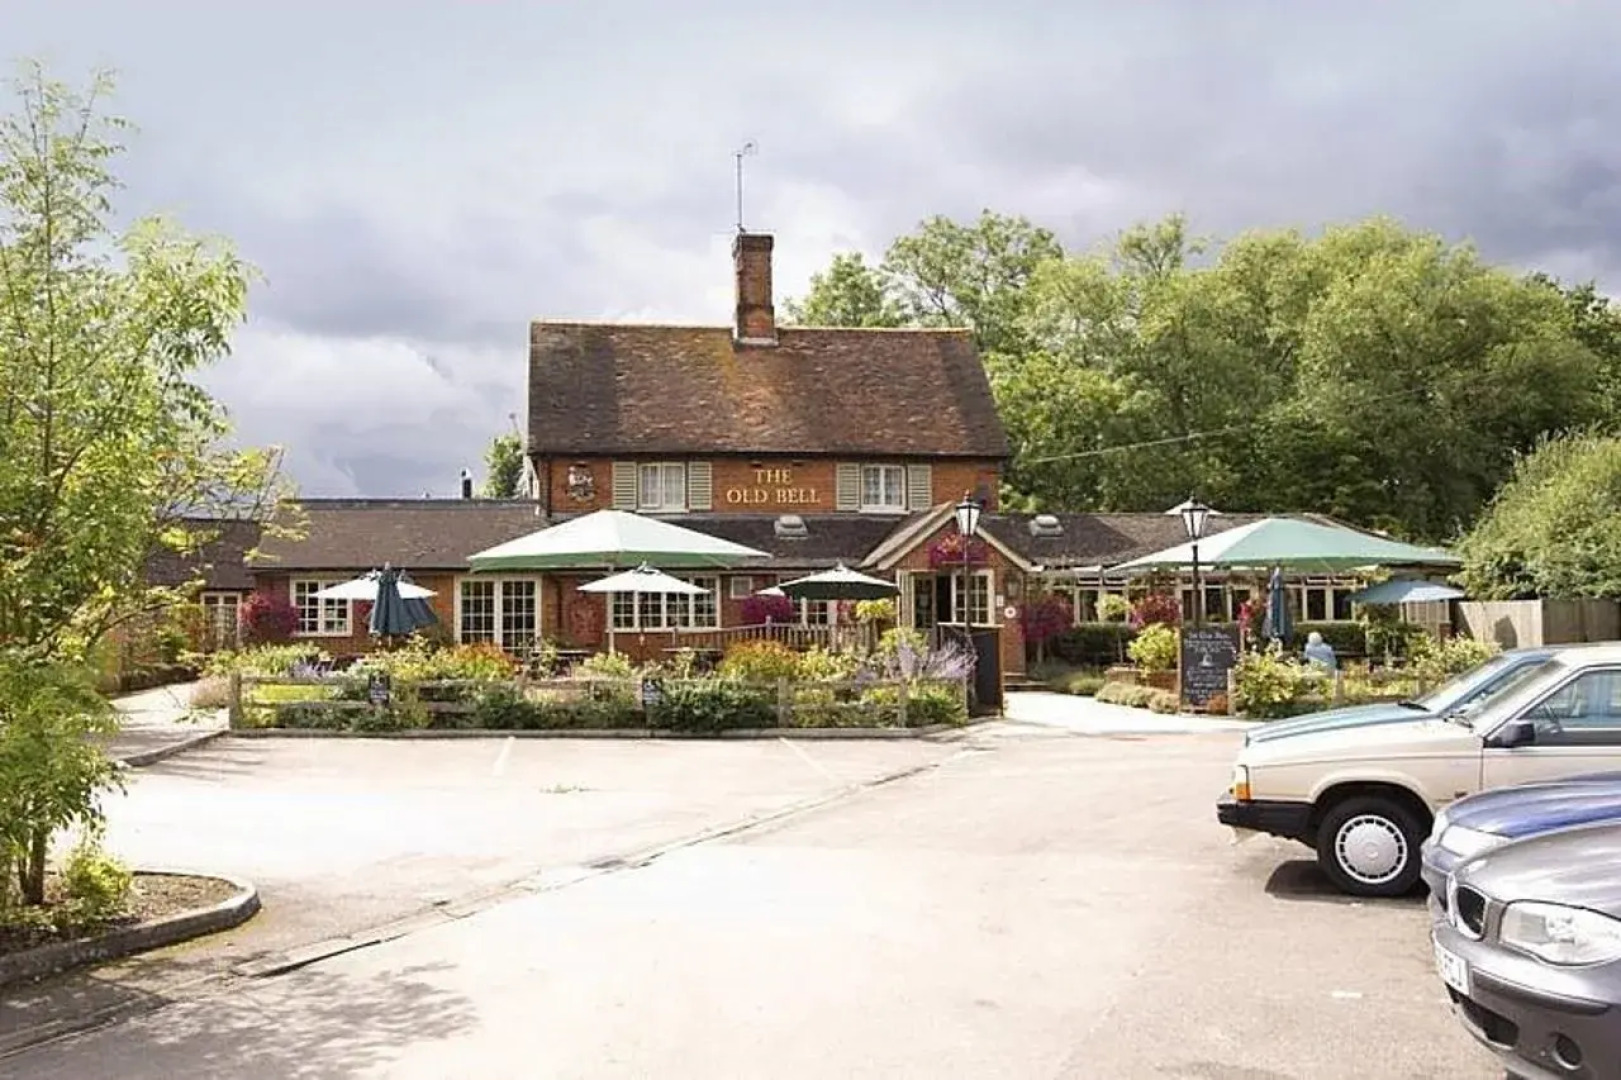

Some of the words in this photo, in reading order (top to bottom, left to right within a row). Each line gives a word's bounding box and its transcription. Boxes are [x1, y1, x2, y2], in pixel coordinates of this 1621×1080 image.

[754, 469, 793, 485] THE
[726, 488, 769, 503] OLD
[776, 488, 821, 503] BELL
